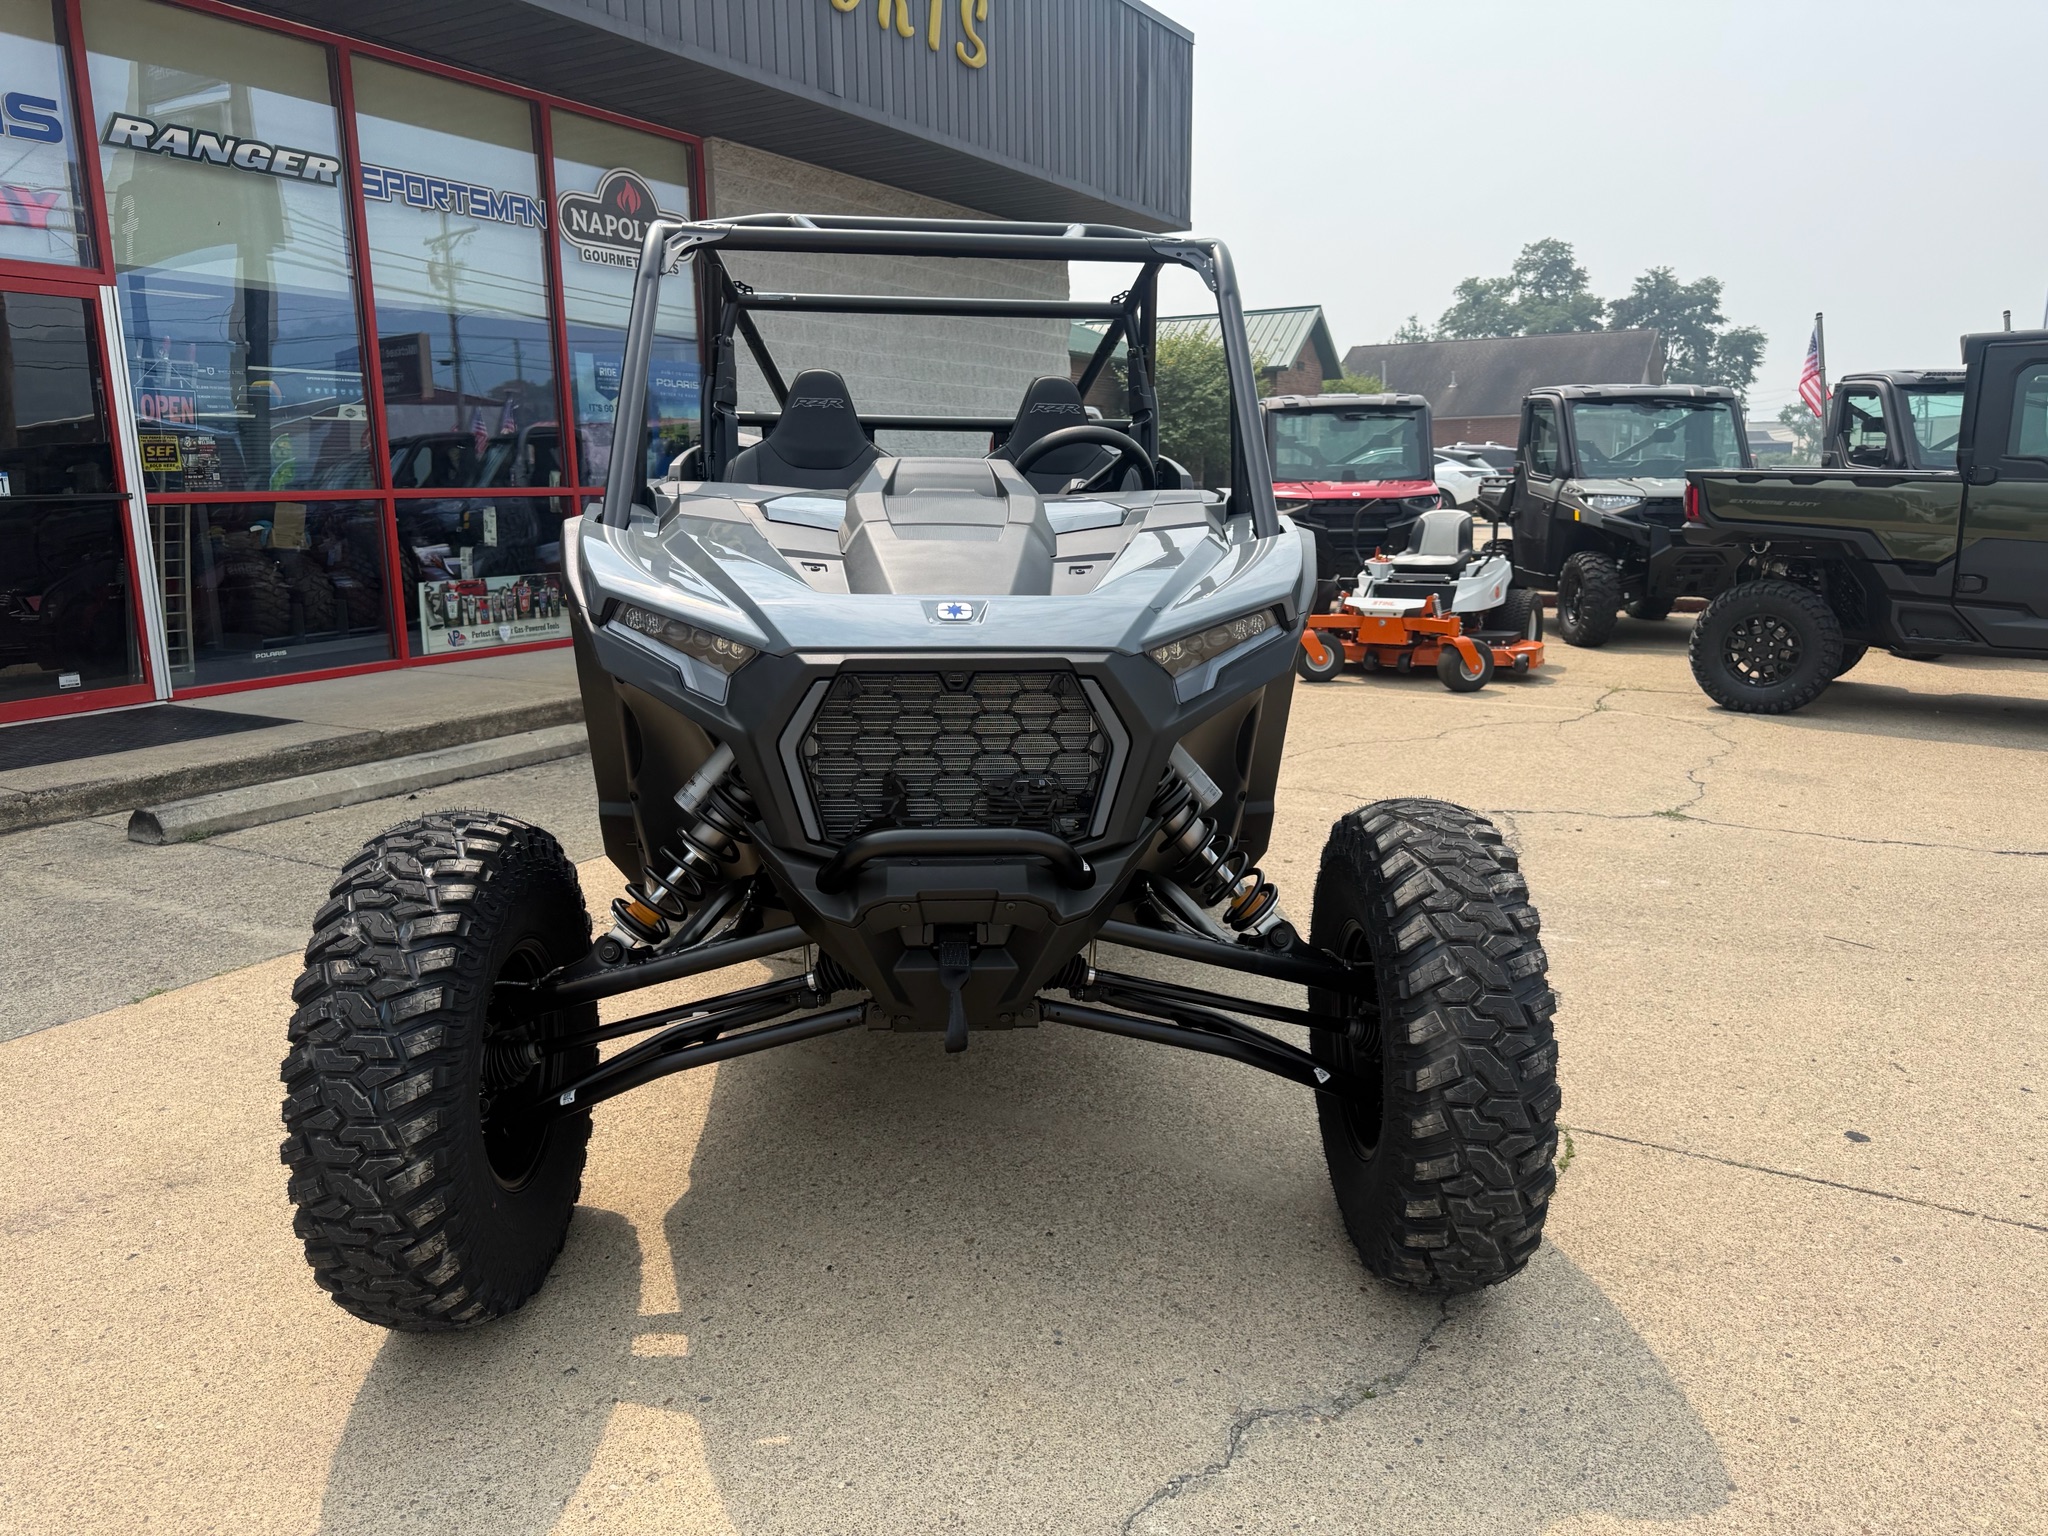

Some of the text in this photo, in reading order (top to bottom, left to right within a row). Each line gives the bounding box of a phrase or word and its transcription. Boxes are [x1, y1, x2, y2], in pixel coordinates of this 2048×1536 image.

[105, 114, 341, 186] RANGER
[361, 164, 547, 229] SPORTSMAN
[570, 207, 650, 242] NAPOL
[583, 249, 639, 268] GOURMET
[599, 367, 617, 377] RIDE
[656, 378, 699, 390] POLARIS
[141, 394, 195, 424] OPEN
[792, 397, 844, 408] RZR
[1030, 403, 1080, 414] RZR
[146, 446, 175, 456] SEF
[472, 630, 491, 639] Perfect
[514, 624, 546, 634] Gas-Powered
[255, 650, 287, 659] POLARIS
